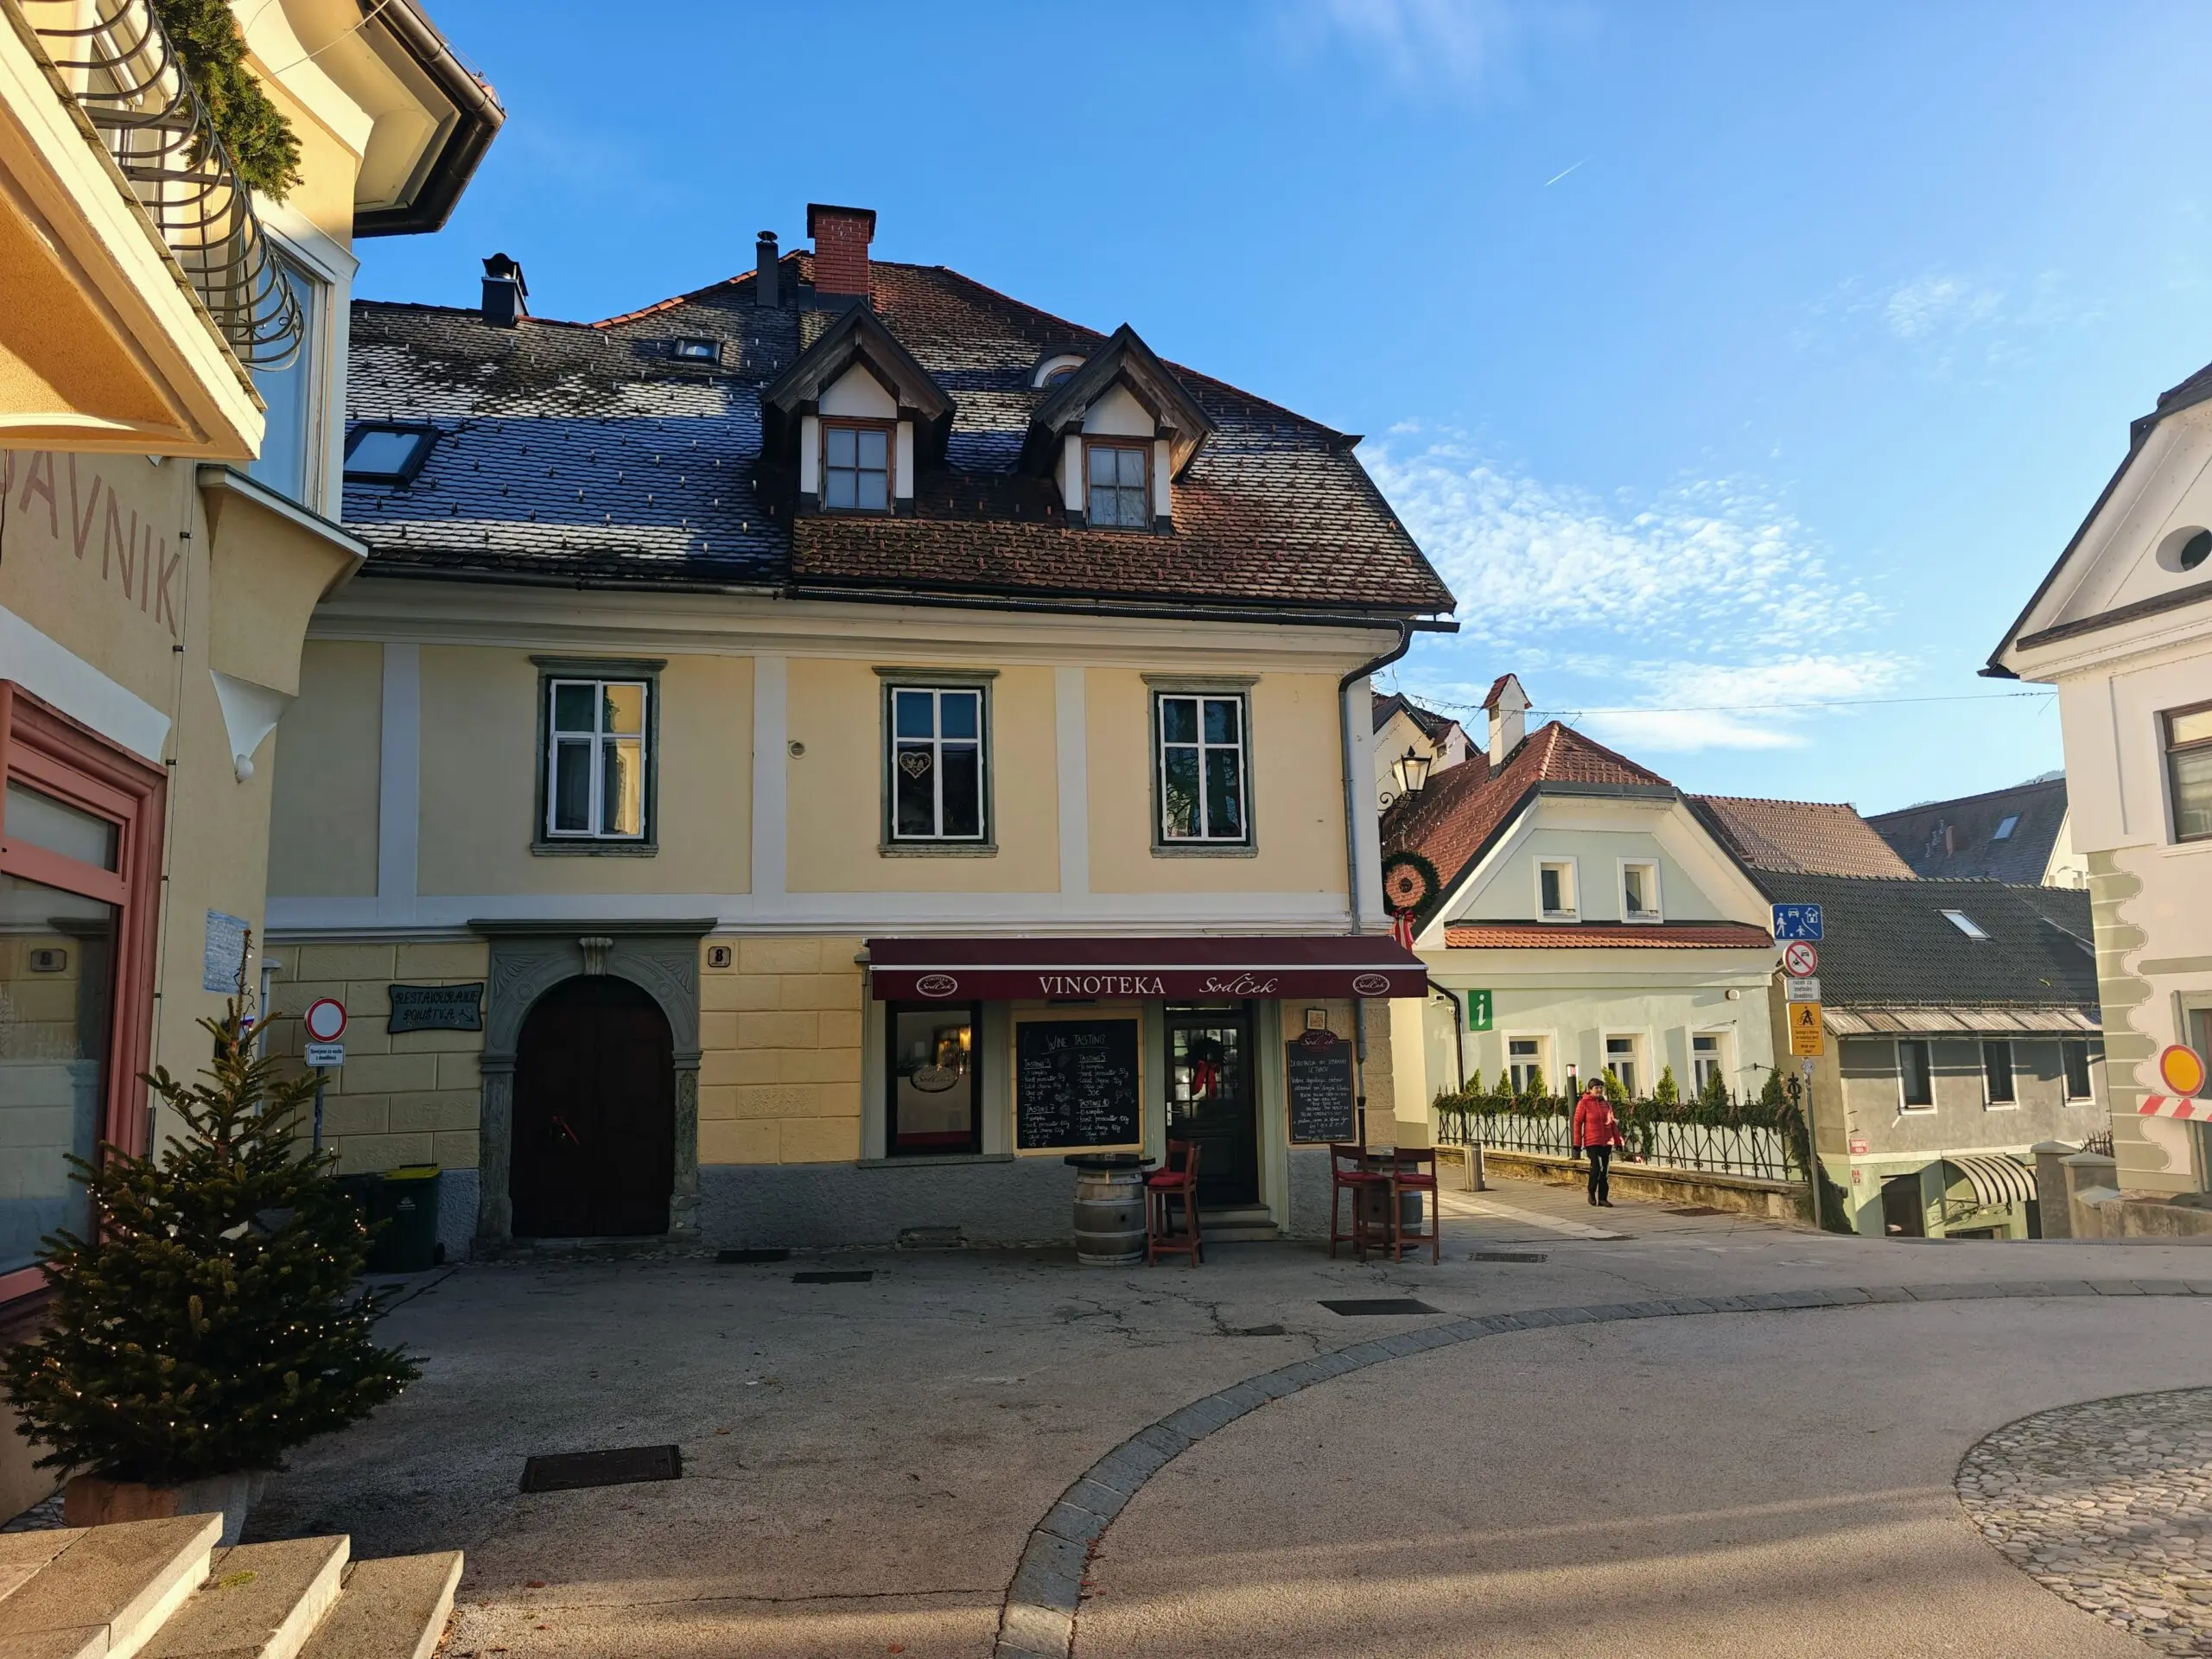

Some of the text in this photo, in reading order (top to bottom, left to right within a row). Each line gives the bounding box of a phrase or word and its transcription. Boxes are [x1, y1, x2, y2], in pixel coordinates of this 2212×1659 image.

[715, 949, 723, 962] 8
[1039, 973, 1278, 995] VINOTEKA SodČek
[1073, 1034, 1106, 1046] TASTING
[1101, 1052, 1107, 1061] 5
